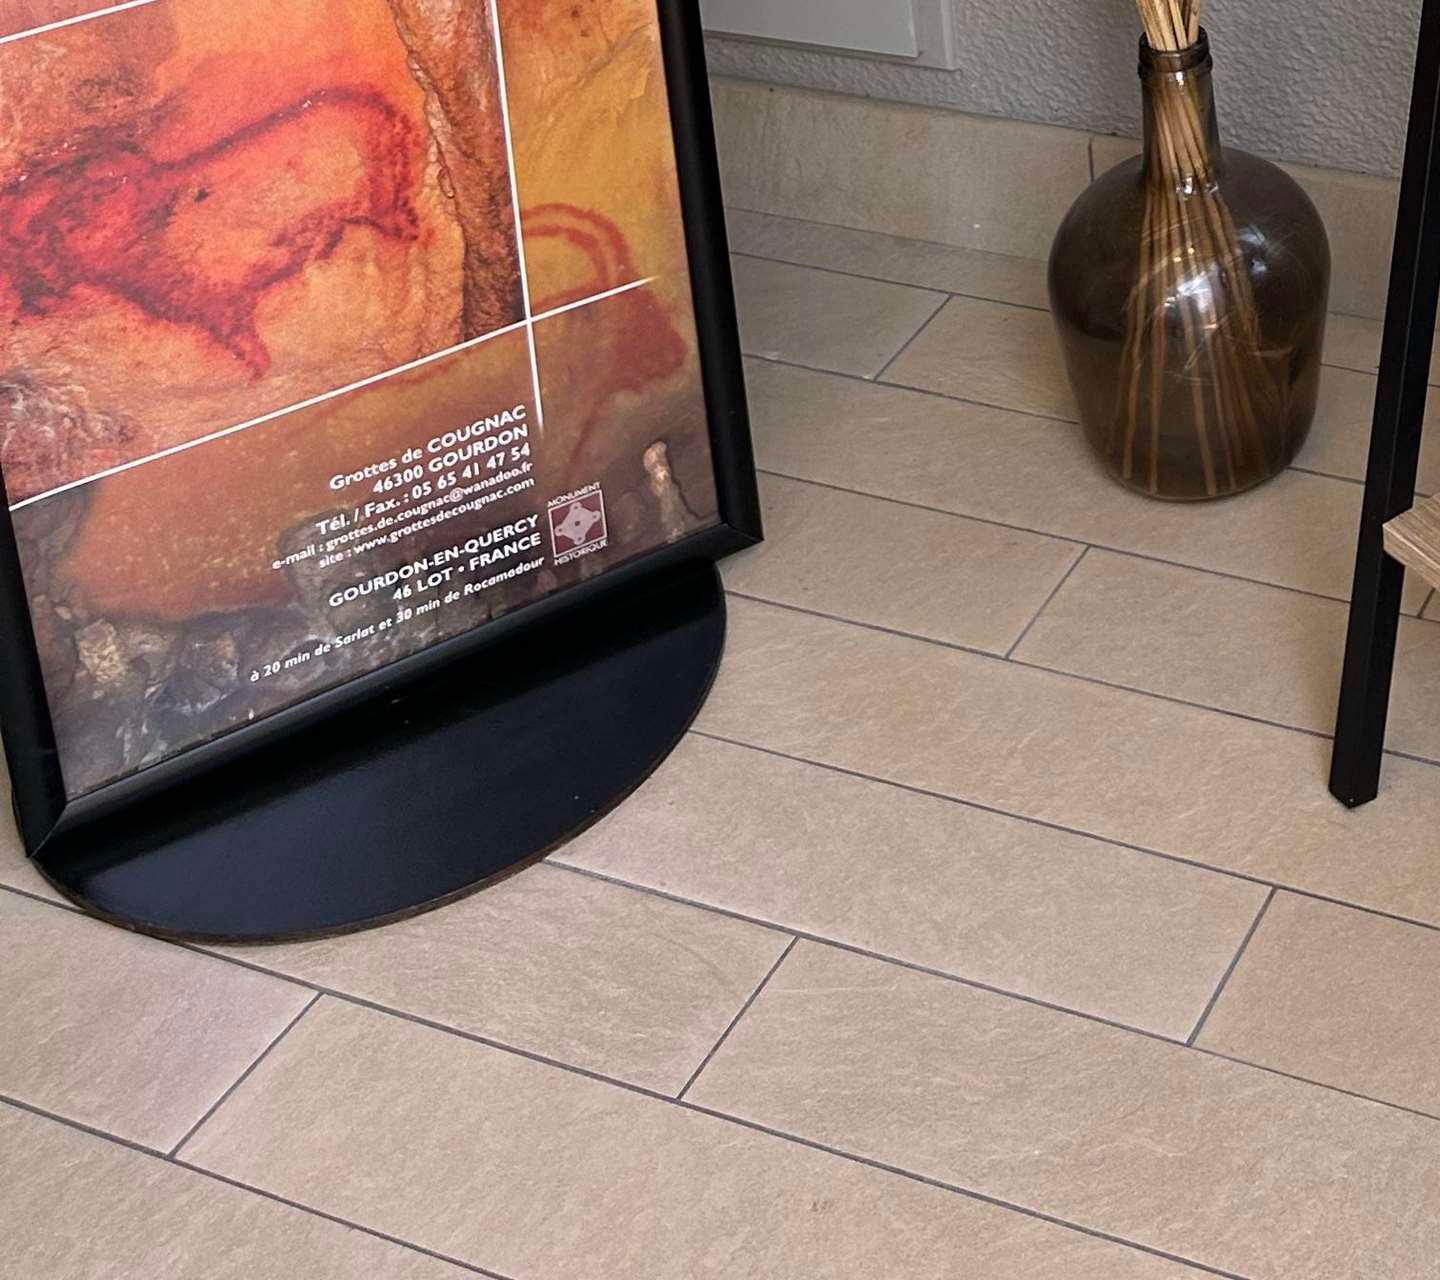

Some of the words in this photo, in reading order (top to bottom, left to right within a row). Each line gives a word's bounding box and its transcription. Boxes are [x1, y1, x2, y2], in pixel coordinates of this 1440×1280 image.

[316, 517, 350, 536] Tél.
[365, 498, 400, 518] Fax.
[412, 482, 432, 499] 05
[437, 471, 457, 490] 65
[462, 462, 480, 479] 41
[486, 452, 505, 470] 47
[511, 442, 531, 462] 54
[329, 458, 398, 490] Grottes
[401, 448, 423, 464] de
[427, 404, 527, 453] COUGNAC
[373, 465, 423, 494] 46300
[428, 423, 529, 472] GOURDON
[272, 547, 316, 570] e-mail
[325, 460, 533, 554] grottes.de.cougnac@wanadoo.fr
[318, 551, 344, 569] site
[353, 476, 535, 555] www.grottesdecougnac.com
[547, 481, 601, 508] MONUMENT
[328, 514, 539, 608] GOURDON-EN-QUERCY
[392, 583, 412, 601] 46
[417, 566, 453, 593] LOT
[469, 531, 542, 572] FRANCE
[250, 669, 259, 683] à
[263, 661, 281, 678] 20
[284, 652, 310, 670] min
[314, 640, 331, 657] de
[334, 625, 375, 648] Sarlat
[378, 619, 392, 631] et
[395, 608, 413, 625] 30
[416, 598, 441, 616] min
[444, 589, 461, 603] de
[464, 556, 545, 595] Rocamadour
